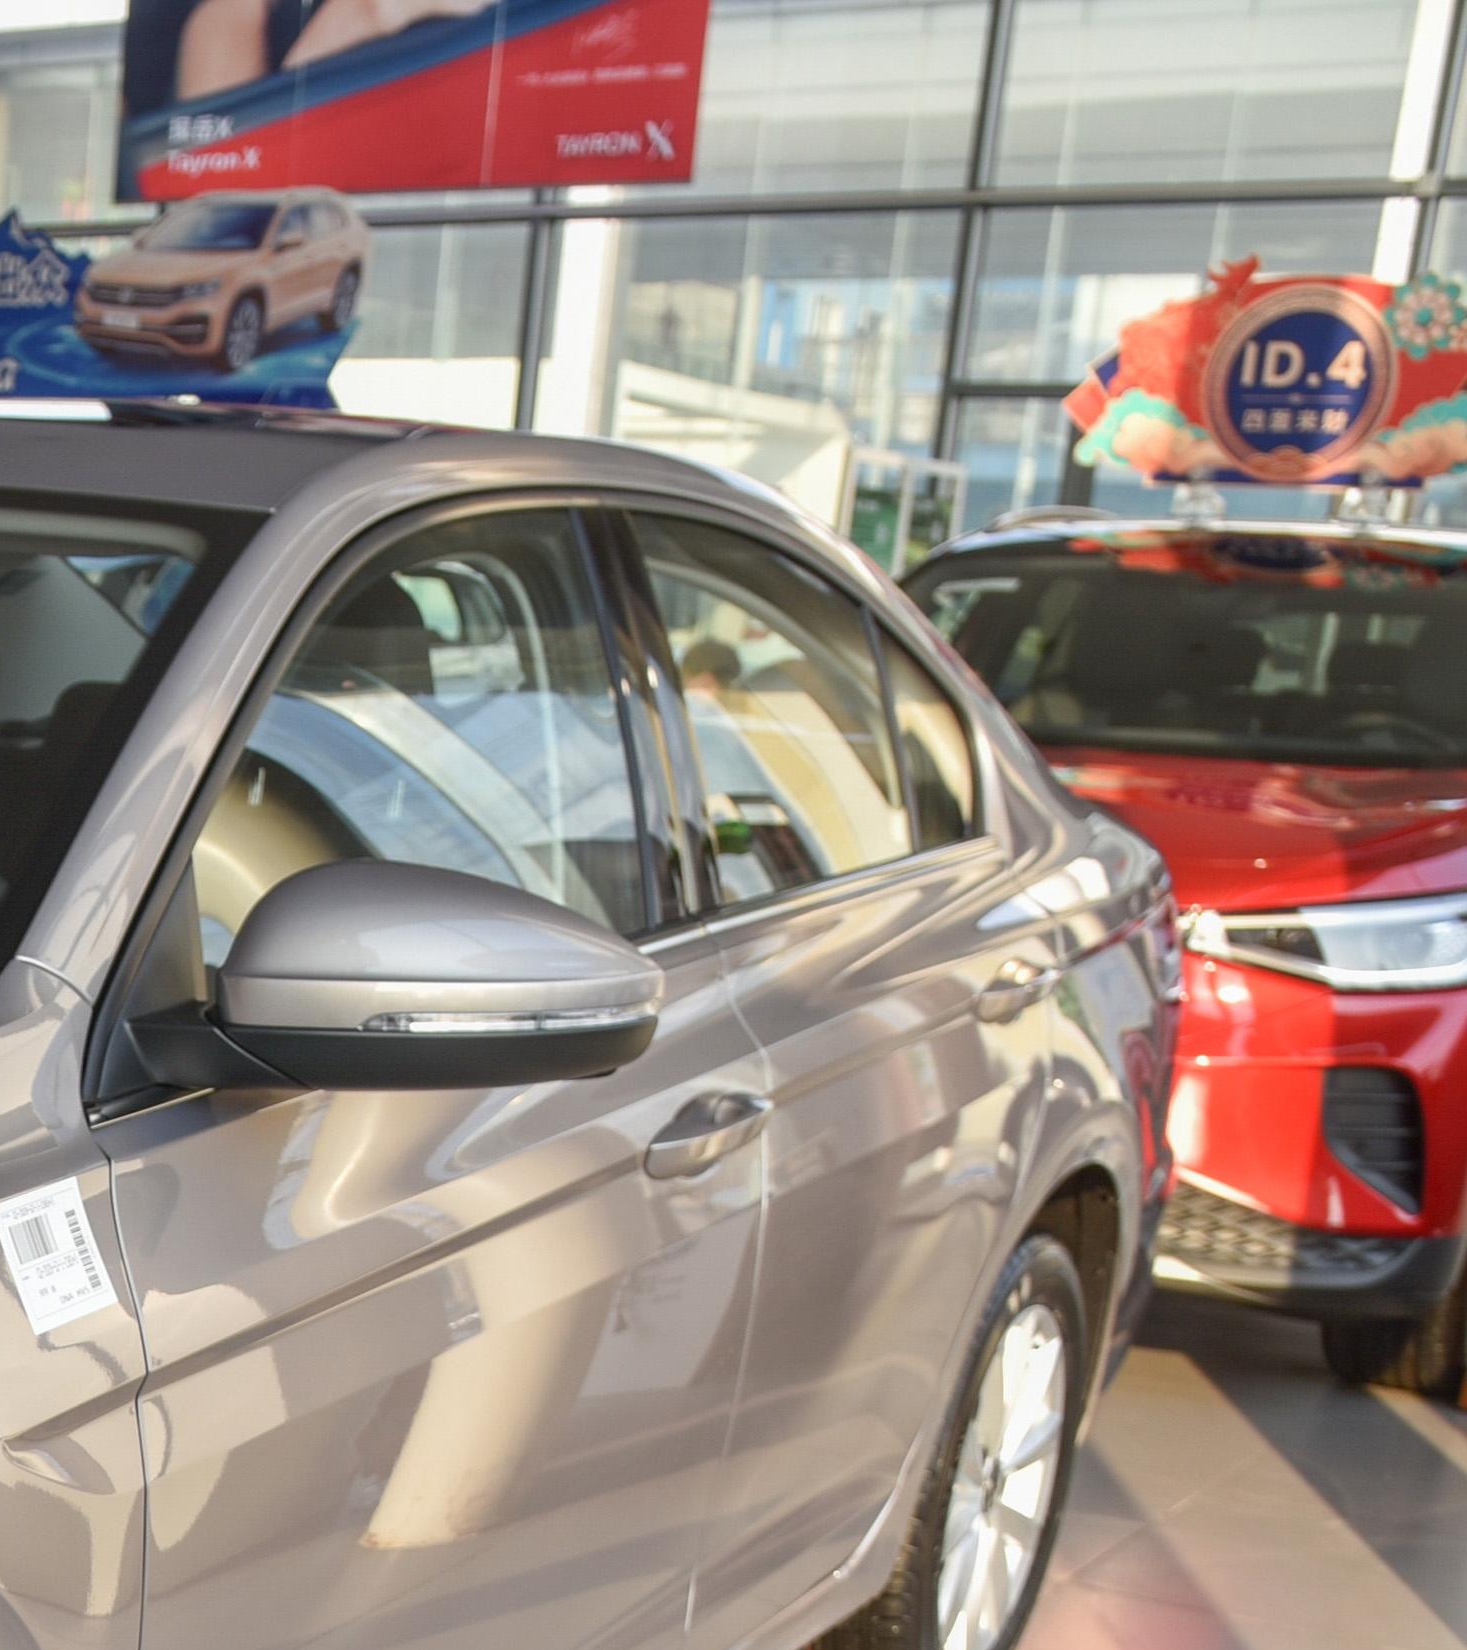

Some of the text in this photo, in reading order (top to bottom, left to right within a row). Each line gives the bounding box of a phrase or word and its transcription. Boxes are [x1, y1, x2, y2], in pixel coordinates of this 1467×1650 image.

[556, 119, 677, 161] TAYRON X
[1239, 340, 1367, 390] ID.4
